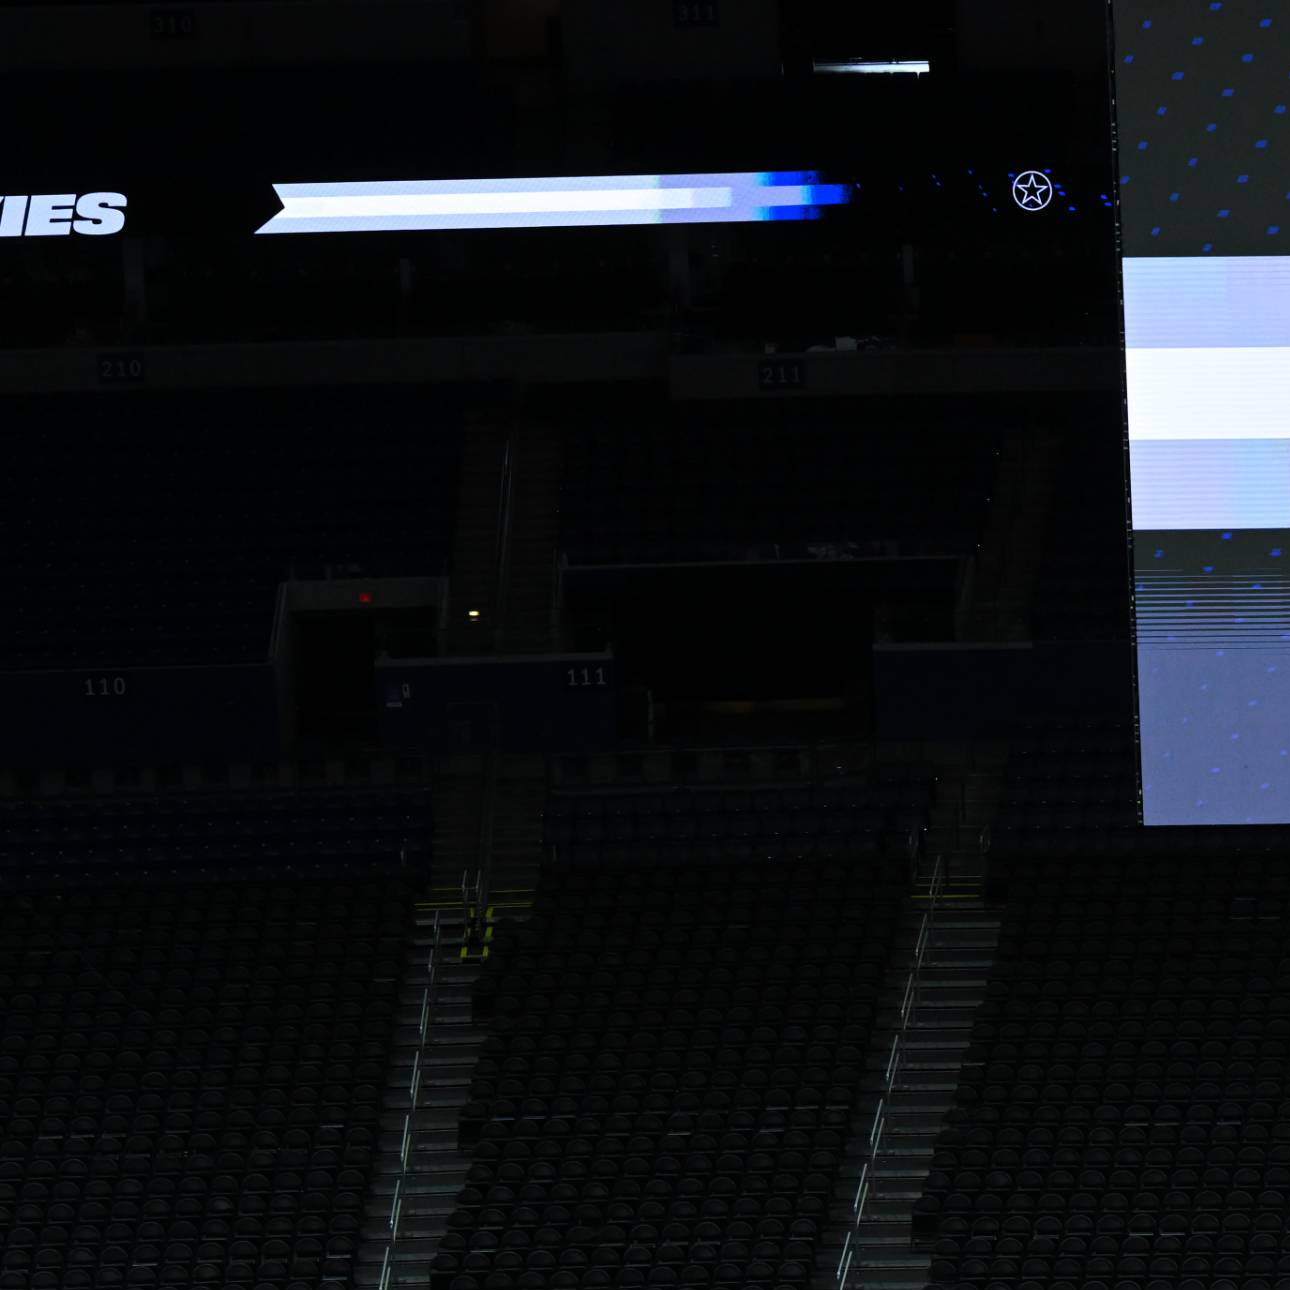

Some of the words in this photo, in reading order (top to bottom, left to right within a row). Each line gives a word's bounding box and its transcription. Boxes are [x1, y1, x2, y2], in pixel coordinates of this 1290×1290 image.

[153, 16, 193, 34] 310
[0, 192, 128, 237] IES
[101, 360, 142, 378] 210
[761, 366, 801, 384] 211
[83, 674, 127, 697] 110
[567, 666, 607, 687] 111
